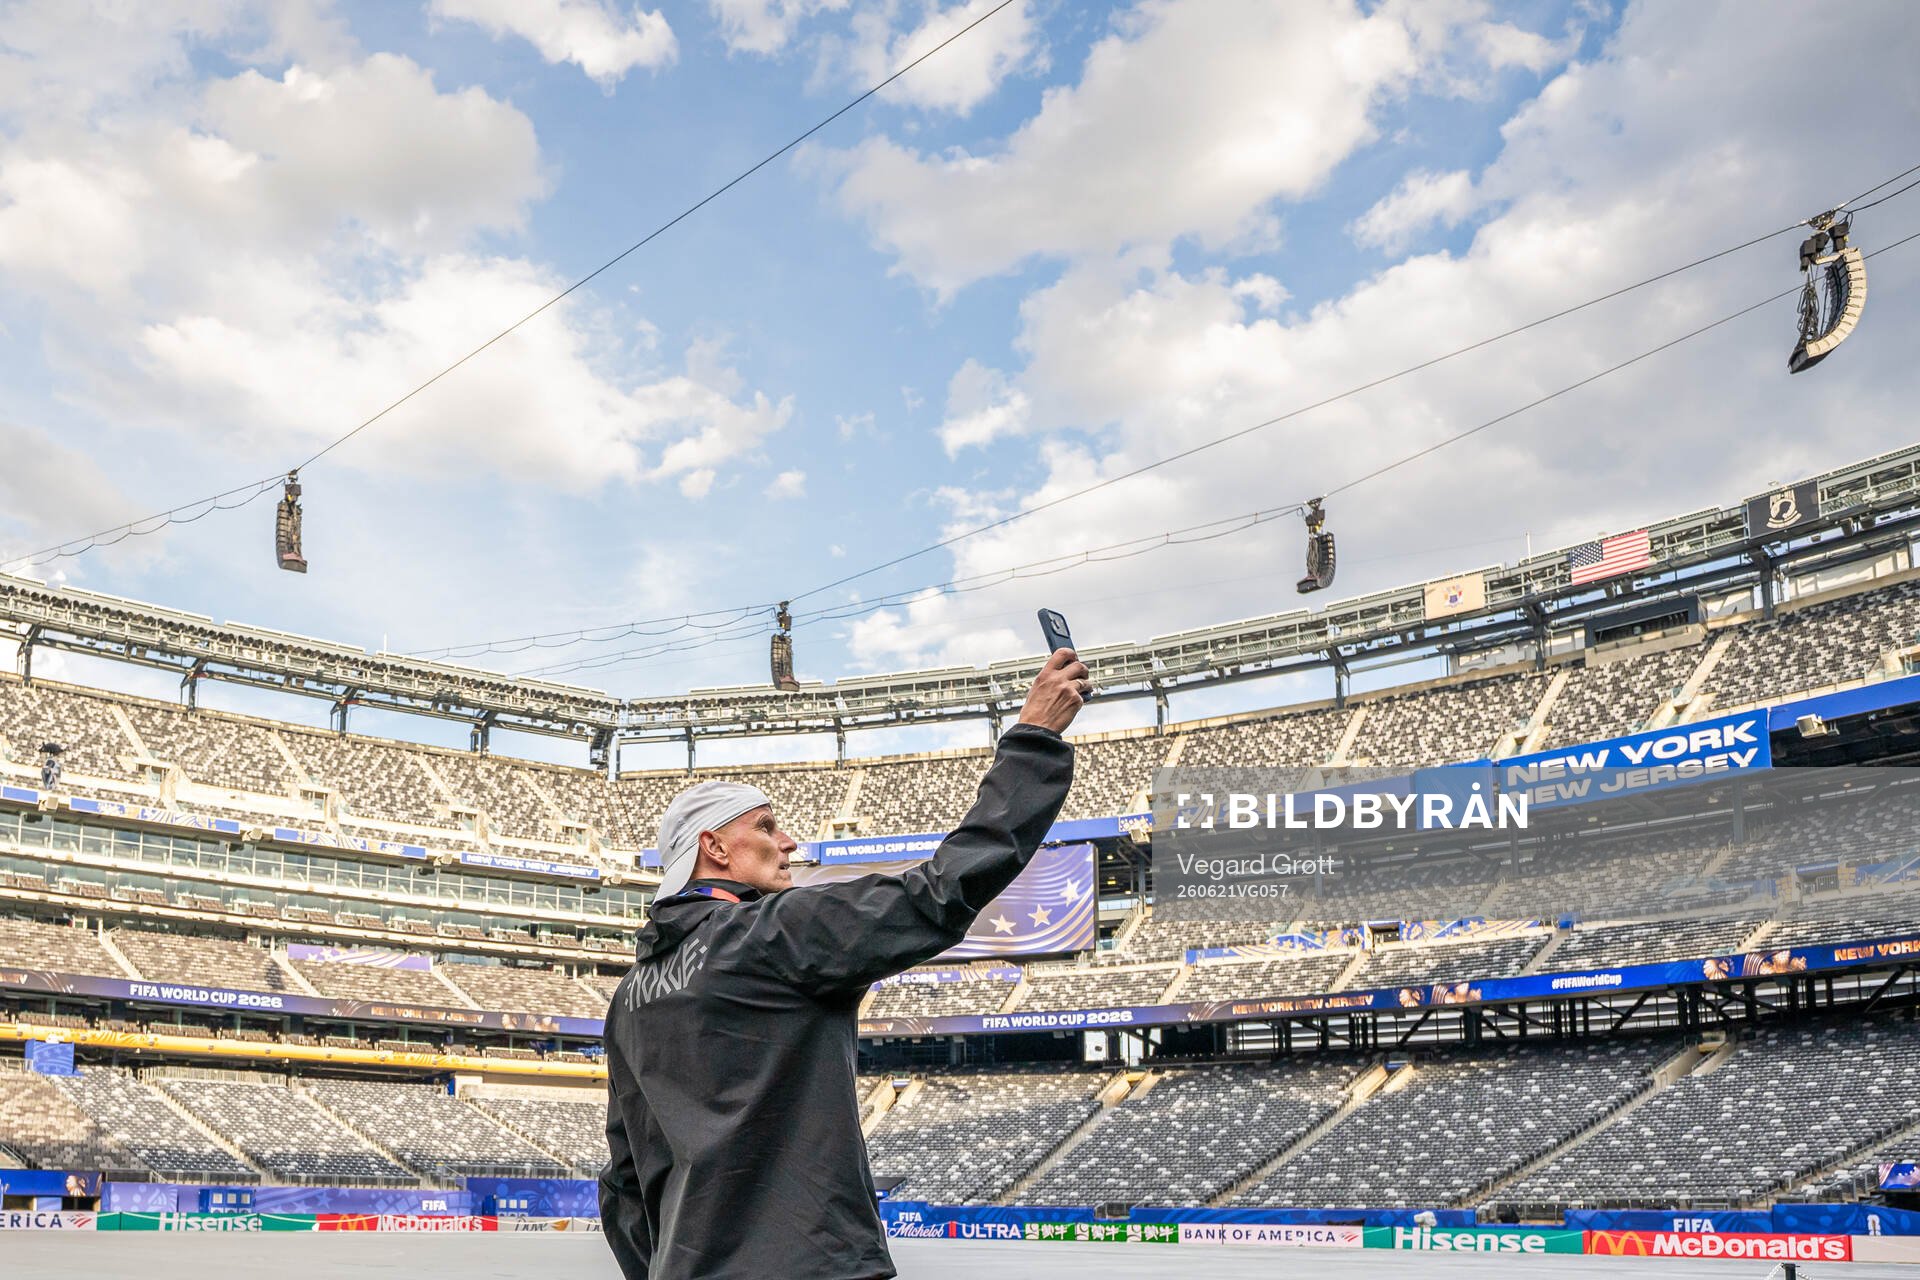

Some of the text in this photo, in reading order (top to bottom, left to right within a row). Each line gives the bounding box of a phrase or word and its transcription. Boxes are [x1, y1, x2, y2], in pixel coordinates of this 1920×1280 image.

[1507, 720, 1758, 787] NEW YORK
[1600, 747, 1758, 793] JERSEY
[825, 846, 848, 857] FIFA
[848, 844, 885, 855] WORLD
[885, 842, 905, 853] CUP
[1834, 945, 1875, 961] NEW
[1551, 974, 1622, 990] #FIFAWorldCup
[129, 983, 283, 1009] FIFA WORLD CUP 2026
[1232, 1003, 1260, 1015] NEW
[1261, 1001, 1294, 1013] YORK
[1325, 994, 1374, 1009] JERSEY
[982, 1010, 1133, 1029] FIFA WORLD CUP 2026
[422, 1200, 448, 1212] FIFA
[159, 1212, 263, 1232] Hisense
[376, 1215, 483, 1232] McDonald's
[899, 1212, 922, 1222] FIFA
[1673, 1218, 1716, 1233] FIFA
[888, 1221, 1021, 1239] Michelob ULTRA
[1184, 1228, 1227, 1240] BANK
[1232, 1229, 1252, 1240] OF
[1394, 1226, 1546, 1253] Hisense
[1652, 1234, 1845, 1259] McDonald's
